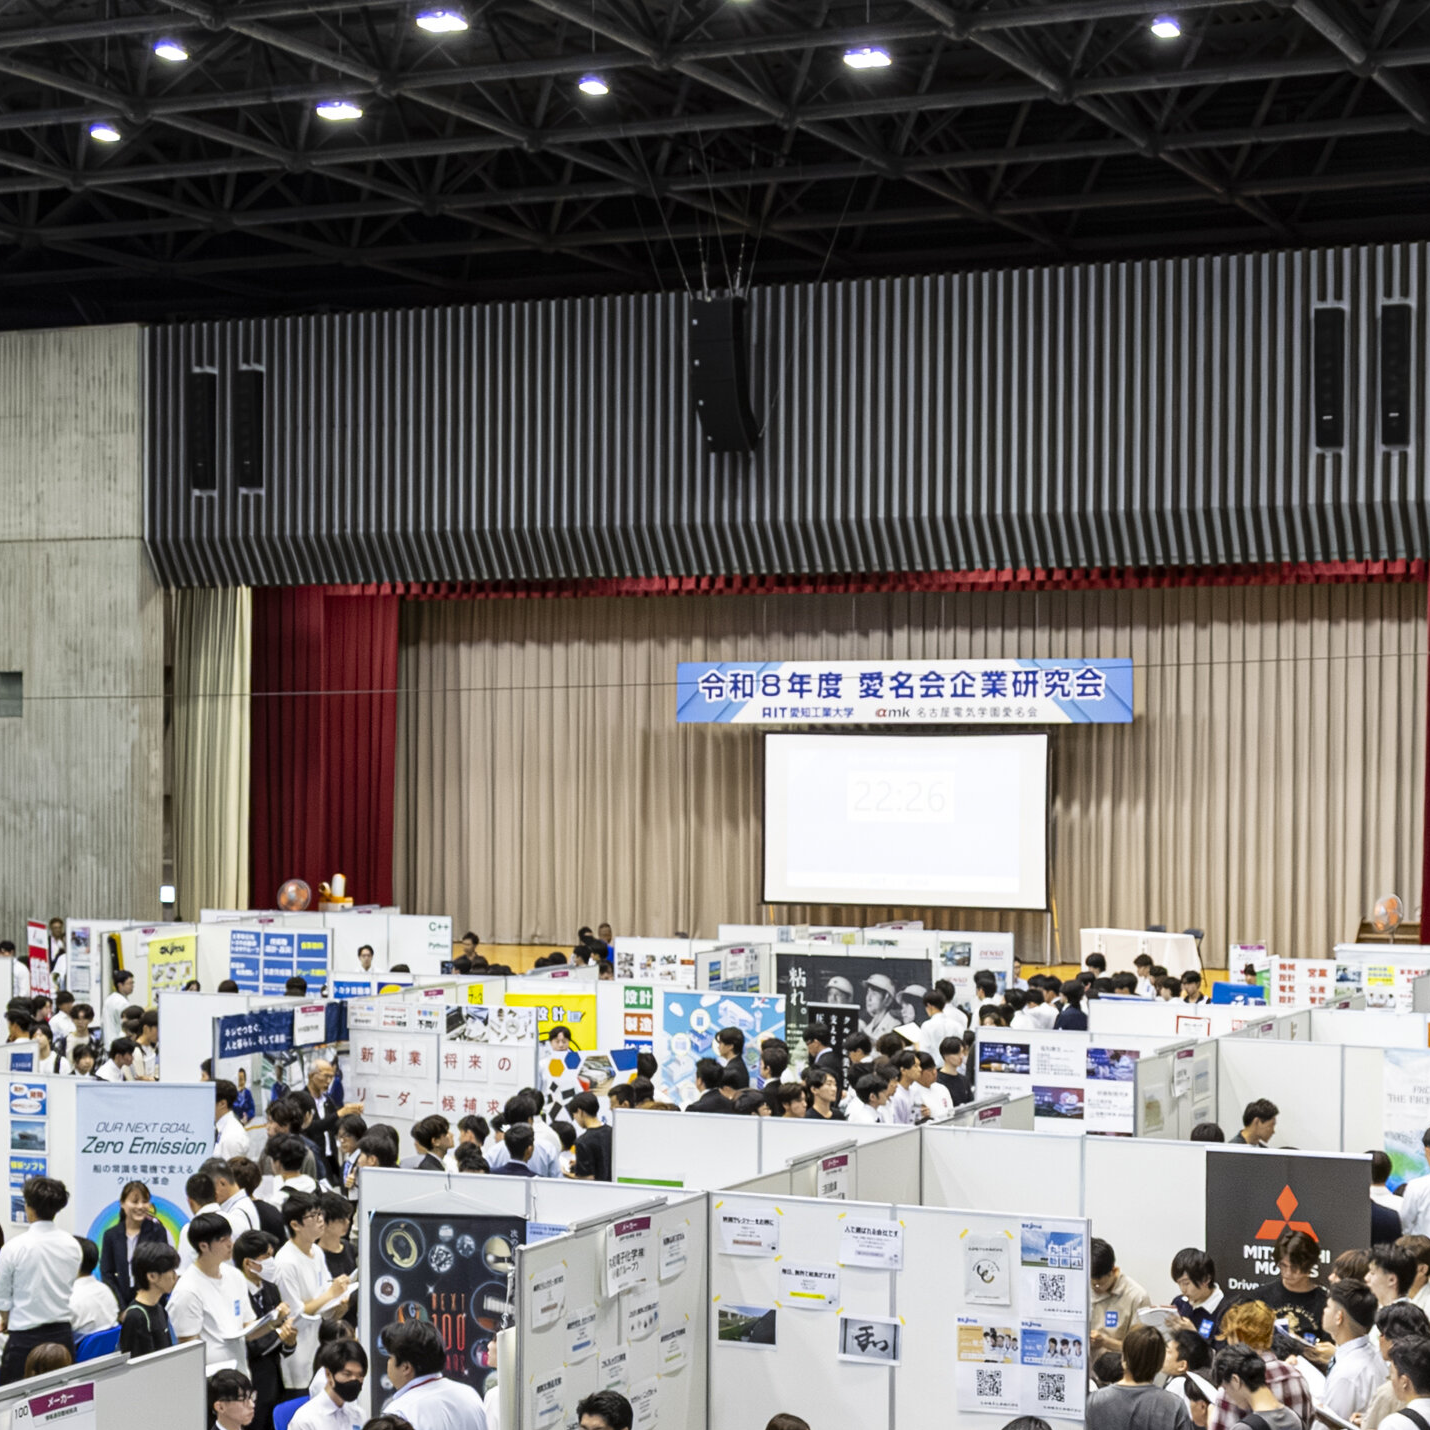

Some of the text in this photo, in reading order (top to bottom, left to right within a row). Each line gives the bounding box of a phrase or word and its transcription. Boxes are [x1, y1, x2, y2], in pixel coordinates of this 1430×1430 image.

[859, 667, 1104, 701] 愛名会企業研究会
[790, 706, 854, 719] 愛知工業大学
[428, 920, 449, 933] C++
[624, 987, 653, 1005] 設計
[444, 1051, 512, 1072] 将来の
[96, 1122, 123, 1133] OUR
[125, 1122, 158, 1133] NEXT
[81, 1136, 207, 1155] Zero Emission
[47, 1391, 75, 1407] メーカー
